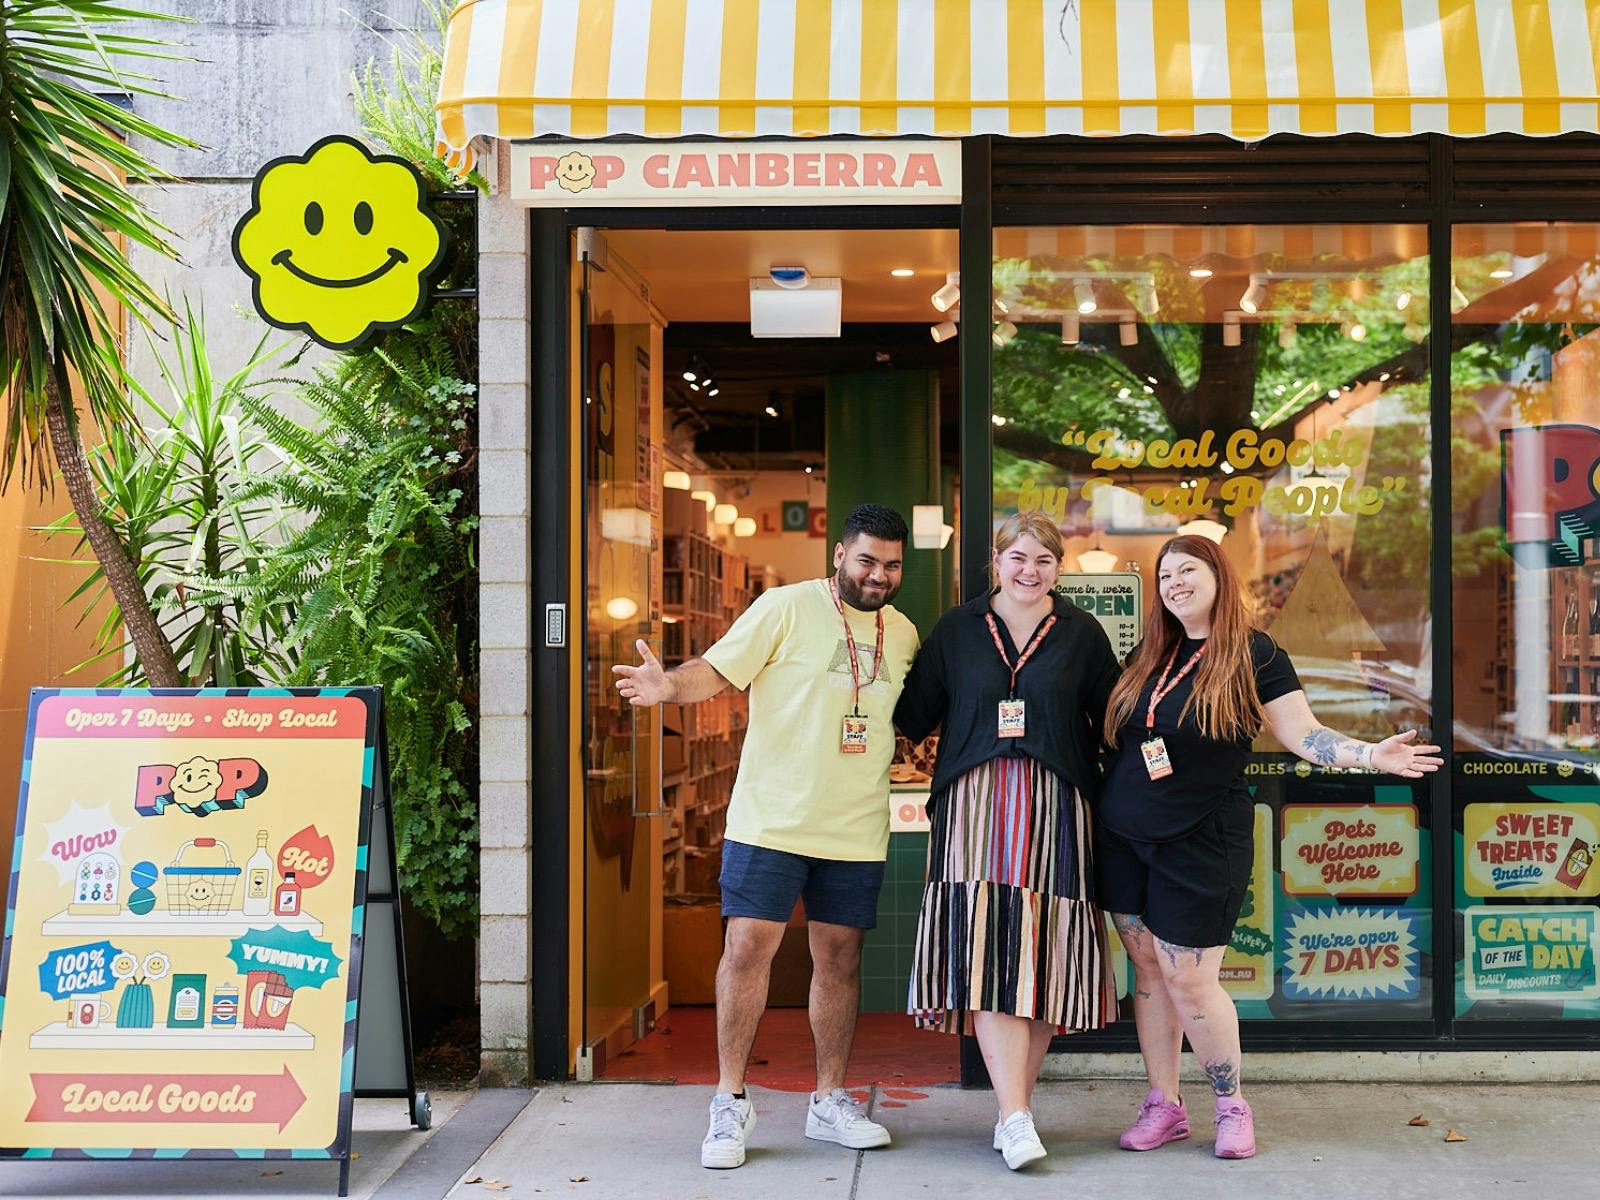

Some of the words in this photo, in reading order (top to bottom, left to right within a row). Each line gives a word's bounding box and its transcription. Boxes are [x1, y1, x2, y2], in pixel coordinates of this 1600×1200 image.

[530, 151, 625, 193] POP
[642, 153, 943, 188] CANBERRA
[1226, 428, 1365, 470] Goods
[1018, 478, 1069, 527] by
[1055, 585, 1084, 594] Come
[1085, 584, 1100, 594] in,
[1103, 584, 1134, 594] we're
[1061, 595, 1134, 616] PEN
[65, 708, 118, 731] Open
[120, 708, 133, 727] 7
[136, 708, 194, 731] Days
[222, 708, 273, 731] Shop
[278, 708, 338, 727] Local
[1244, 763, 1286, 775] DLES
[1463, 762, 1548, 775] CHOCOLATE
[135, 756, 268, 817] POP
[1324, 819, 1377, 841] Pets
[1496, 813, 1574, 838] SWEET
[51, 828, 117, 861] Wow
[1298, 841, 1403, 864] Welcome
[1477, 840, 1558, 864] TREATS
[282, 846, 330, 876] Hot
[1321, 862, 1380, 884] Here
[1492, 865, 1543, 881] Inside
[1299, 932, 1356, 950] We're
[1358, 930, 1399, 951] open
[1478, 918, 1587, 942] CATCH
[55, 948, 105, 974] 100%
[241, 943, 330, 974] YUMMY!
[1299, 951, 1316, 976] 7
[1324, 944, 1400, 974] DAYS
[1485, 952, 1499, 964] OF
[1503, 950, 1523, 962] THE
[1532, 944, 1586, 970] DAY
[56, 967, 106, 994] LOCAL
[1478, 973, 1506, 985] DAILY
[1506, 974, 1561, 989] DISCOUNTS
[61, 1083, 154, 1113] Local
[157, 1083, 256, 1113] Goods
